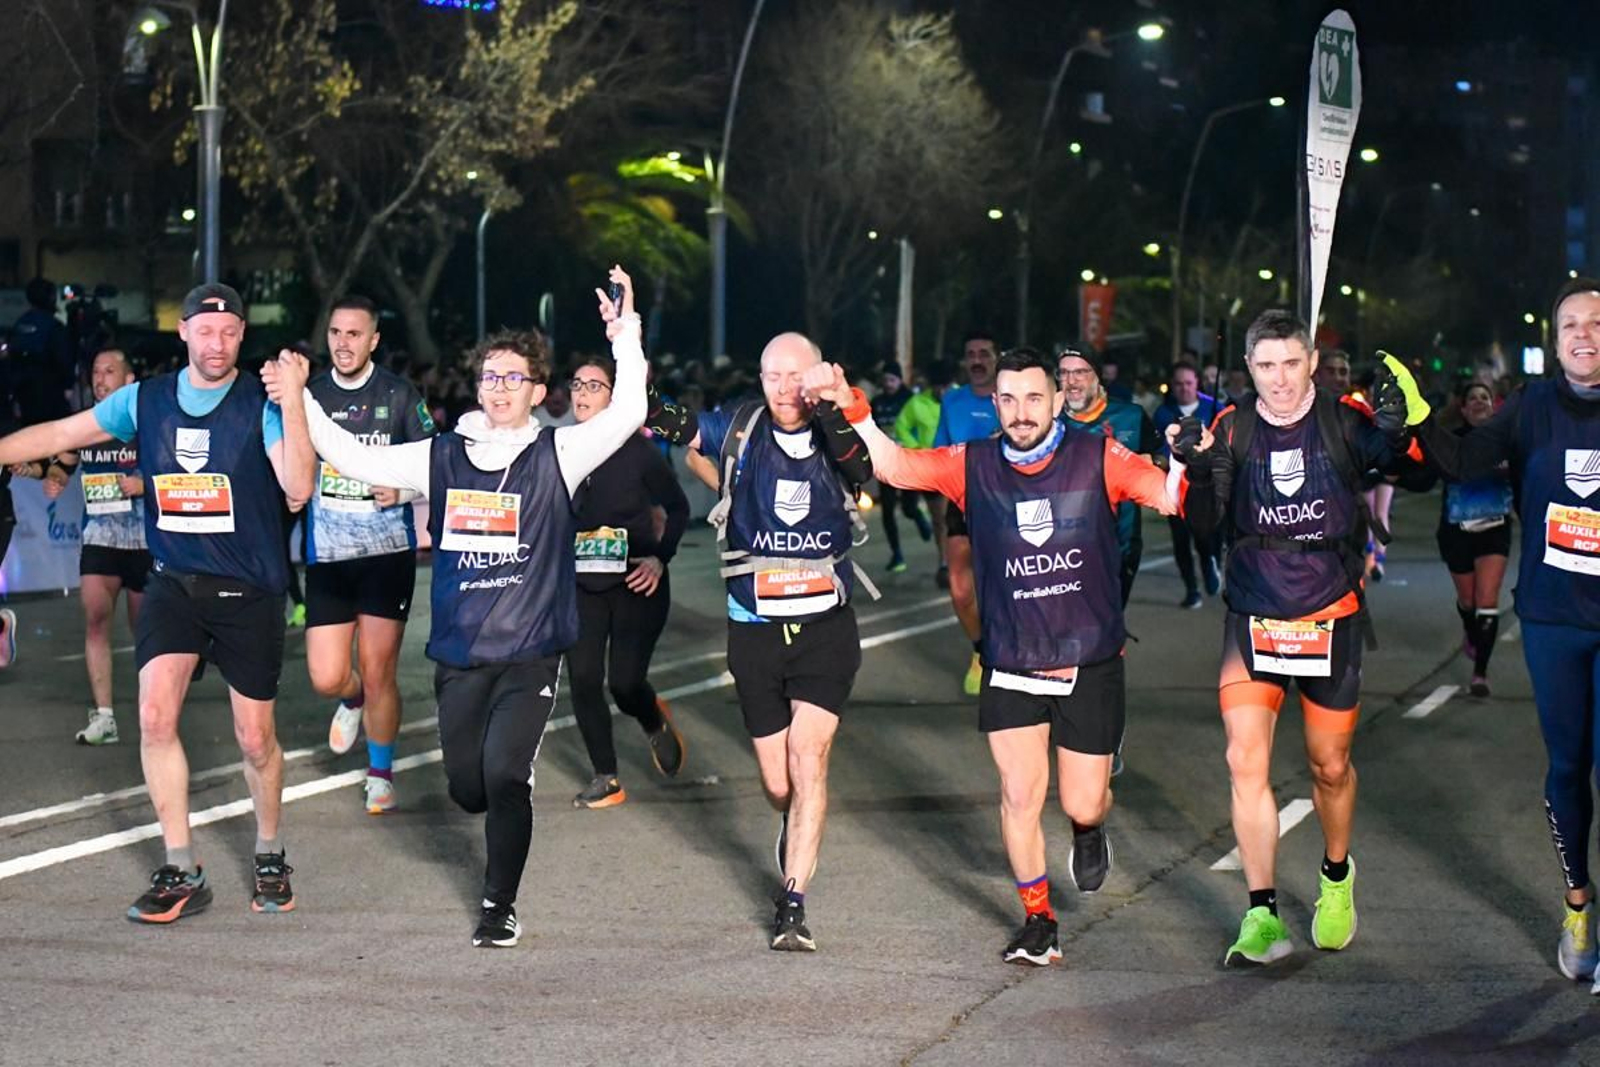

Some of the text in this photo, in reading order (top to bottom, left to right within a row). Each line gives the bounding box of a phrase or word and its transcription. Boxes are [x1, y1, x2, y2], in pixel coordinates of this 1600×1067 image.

[1319, 27, 1338, 46] DEA
[95, 447, 137, 463] ANTÓN
[167, 489, 219, 499] AUXILIAR
[454, 505, 506, 519] AUXILIAR
[1258, 499, 1325, 525] MEDAC
[576, 539, 623, 556] 2214
[752, 531, 832, 551] MEDAC
[1573, 539, 1599, 552] RCP
[457, 543, 530, 570] MEDAC
[1005, 548, 1083, 578] MEDAC
[767, 570, 822, 584] AUXILIAR
[1012, 580, 1082, 600] #FamiliaMEDAC
[1261, 630, 1319, 641] AUXILIAR
